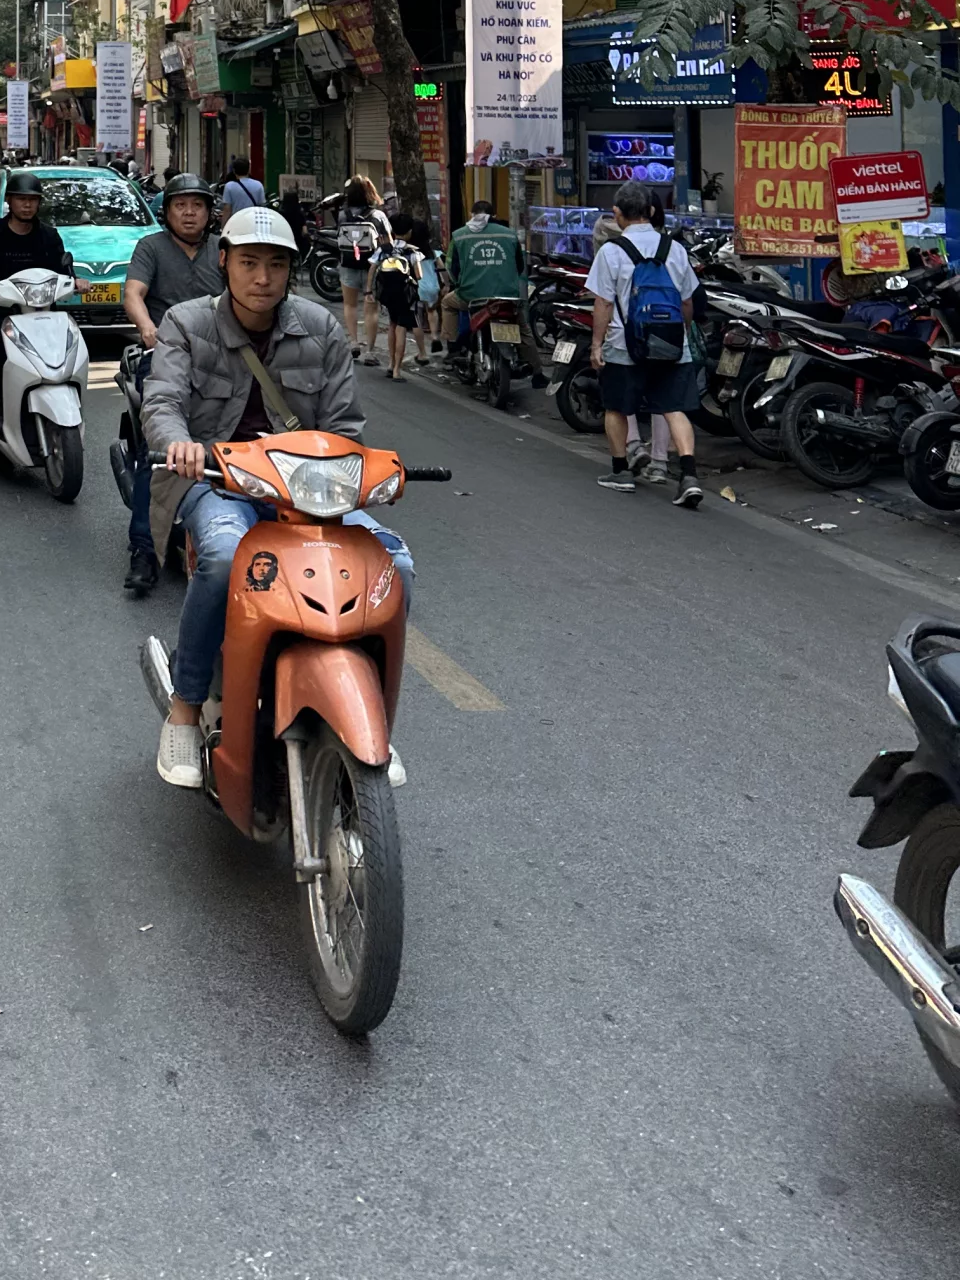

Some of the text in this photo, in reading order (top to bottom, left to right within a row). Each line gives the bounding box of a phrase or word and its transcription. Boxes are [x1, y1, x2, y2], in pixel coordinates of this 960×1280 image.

[496, 0, 514, 9] KHU
[496, 35, 515, 45] PHỤ
[496, 53, 514, 62] KHU
[812, 58, 838, 69] RANG
[781, 112, 799, 123] GIA
[741, 131, 840, 170] THUỐC
[852, 162, 904, 178] viettel
[837, 178, 922, 197] ĐIỂM BÁN HÀNG
[755, 179, 824, 210] CAM
[740, 214, 797, 233] HÀNG
[480, 248, 496, 258] 137
[92, 284, 109, 294] 29E
[302, 540, 343, 550] HONDA
